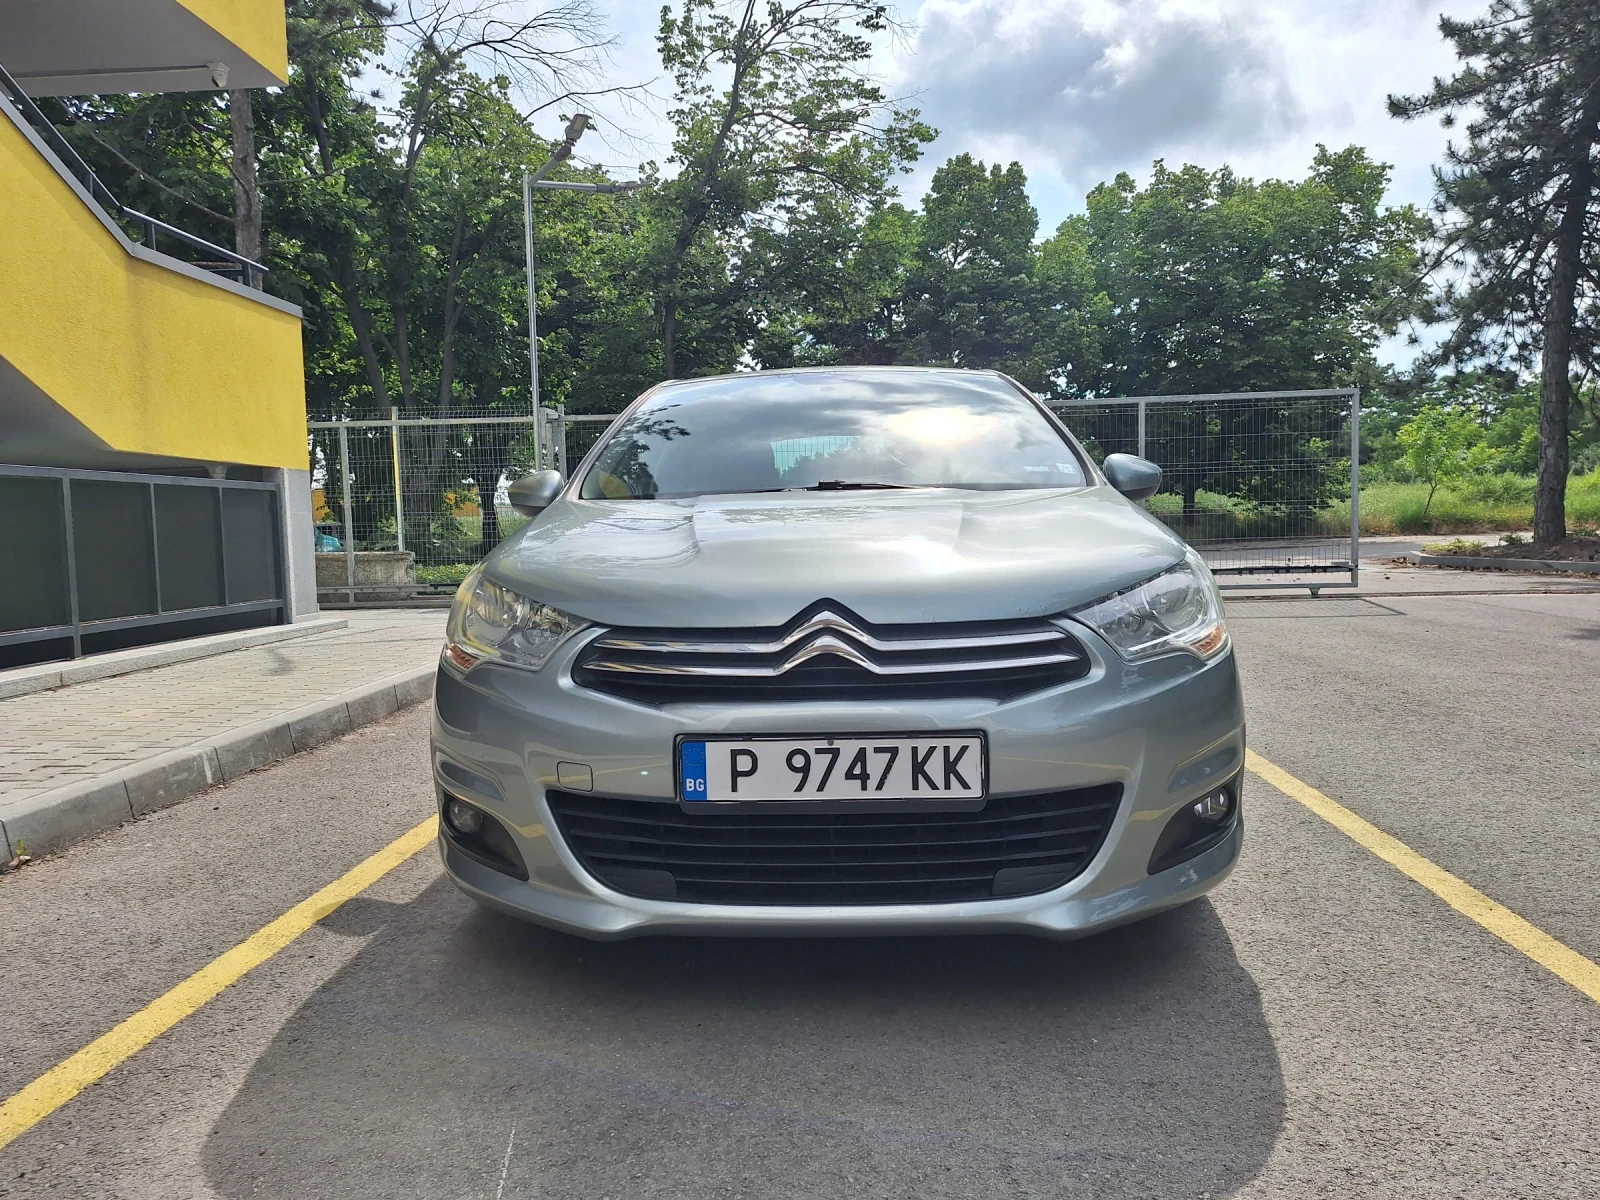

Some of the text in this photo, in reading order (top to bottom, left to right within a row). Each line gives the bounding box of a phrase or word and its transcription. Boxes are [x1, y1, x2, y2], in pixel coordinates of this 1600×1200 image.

[730, 745, 972, 792] P 9747 KK
[686, 778, 705, 791] BG
